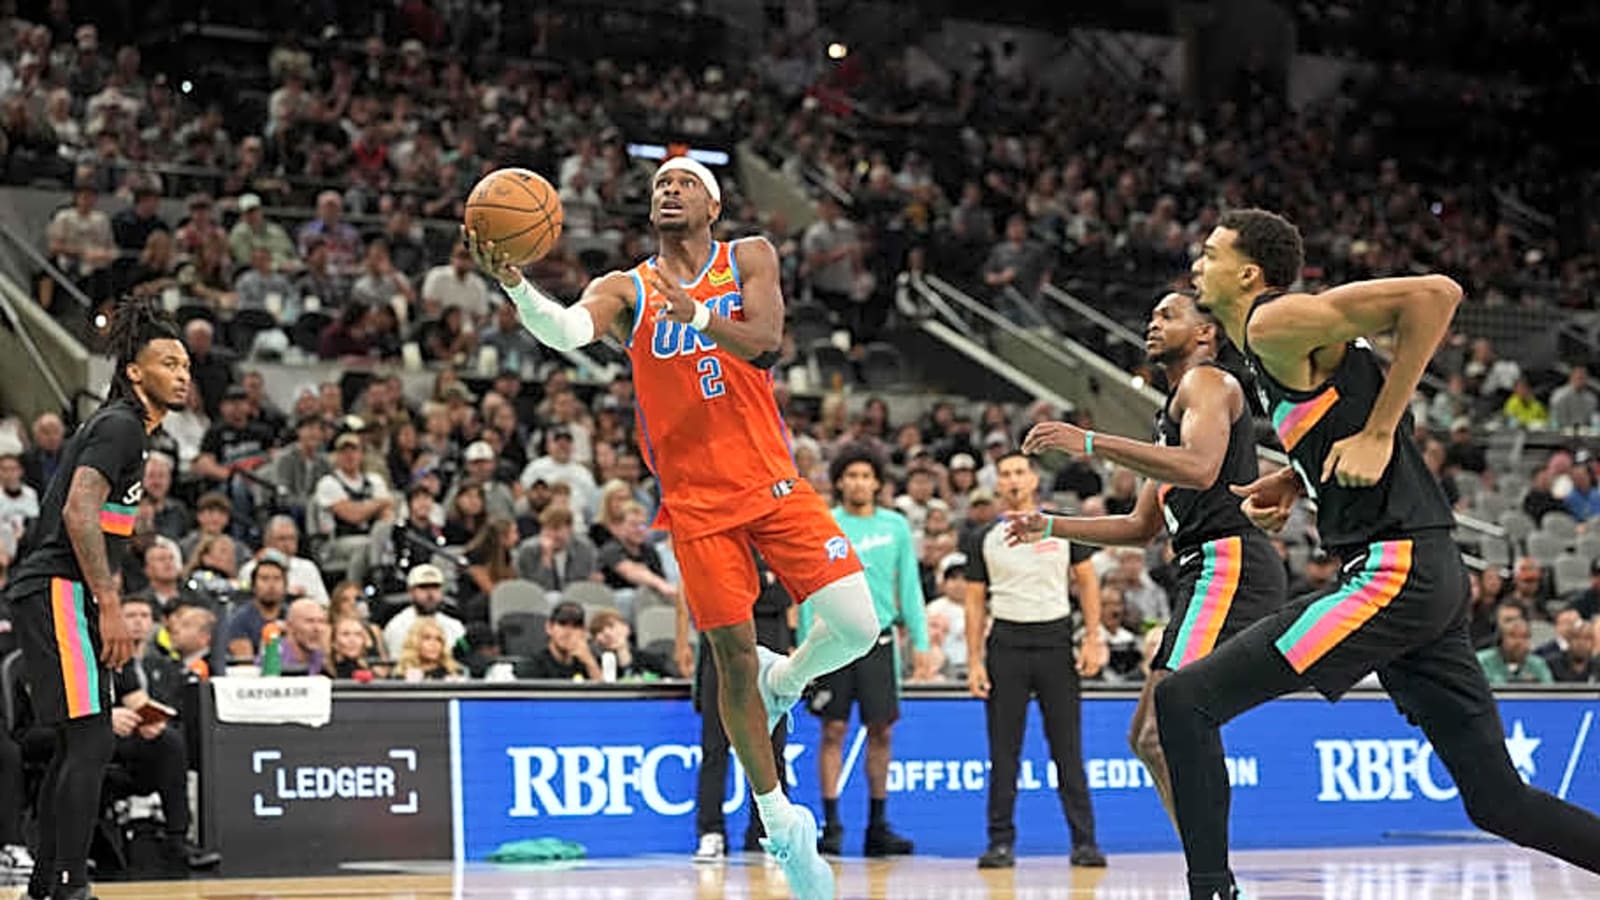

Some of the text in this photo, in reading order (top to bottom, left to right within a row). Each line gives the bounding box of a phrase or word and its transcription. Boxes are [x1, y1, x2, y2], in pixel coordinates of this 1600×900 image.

[697, 355, 726, 399] 2
[276, 766, 396, 799] LEDGER
[886, 759, 1042, 792] OFFICL
